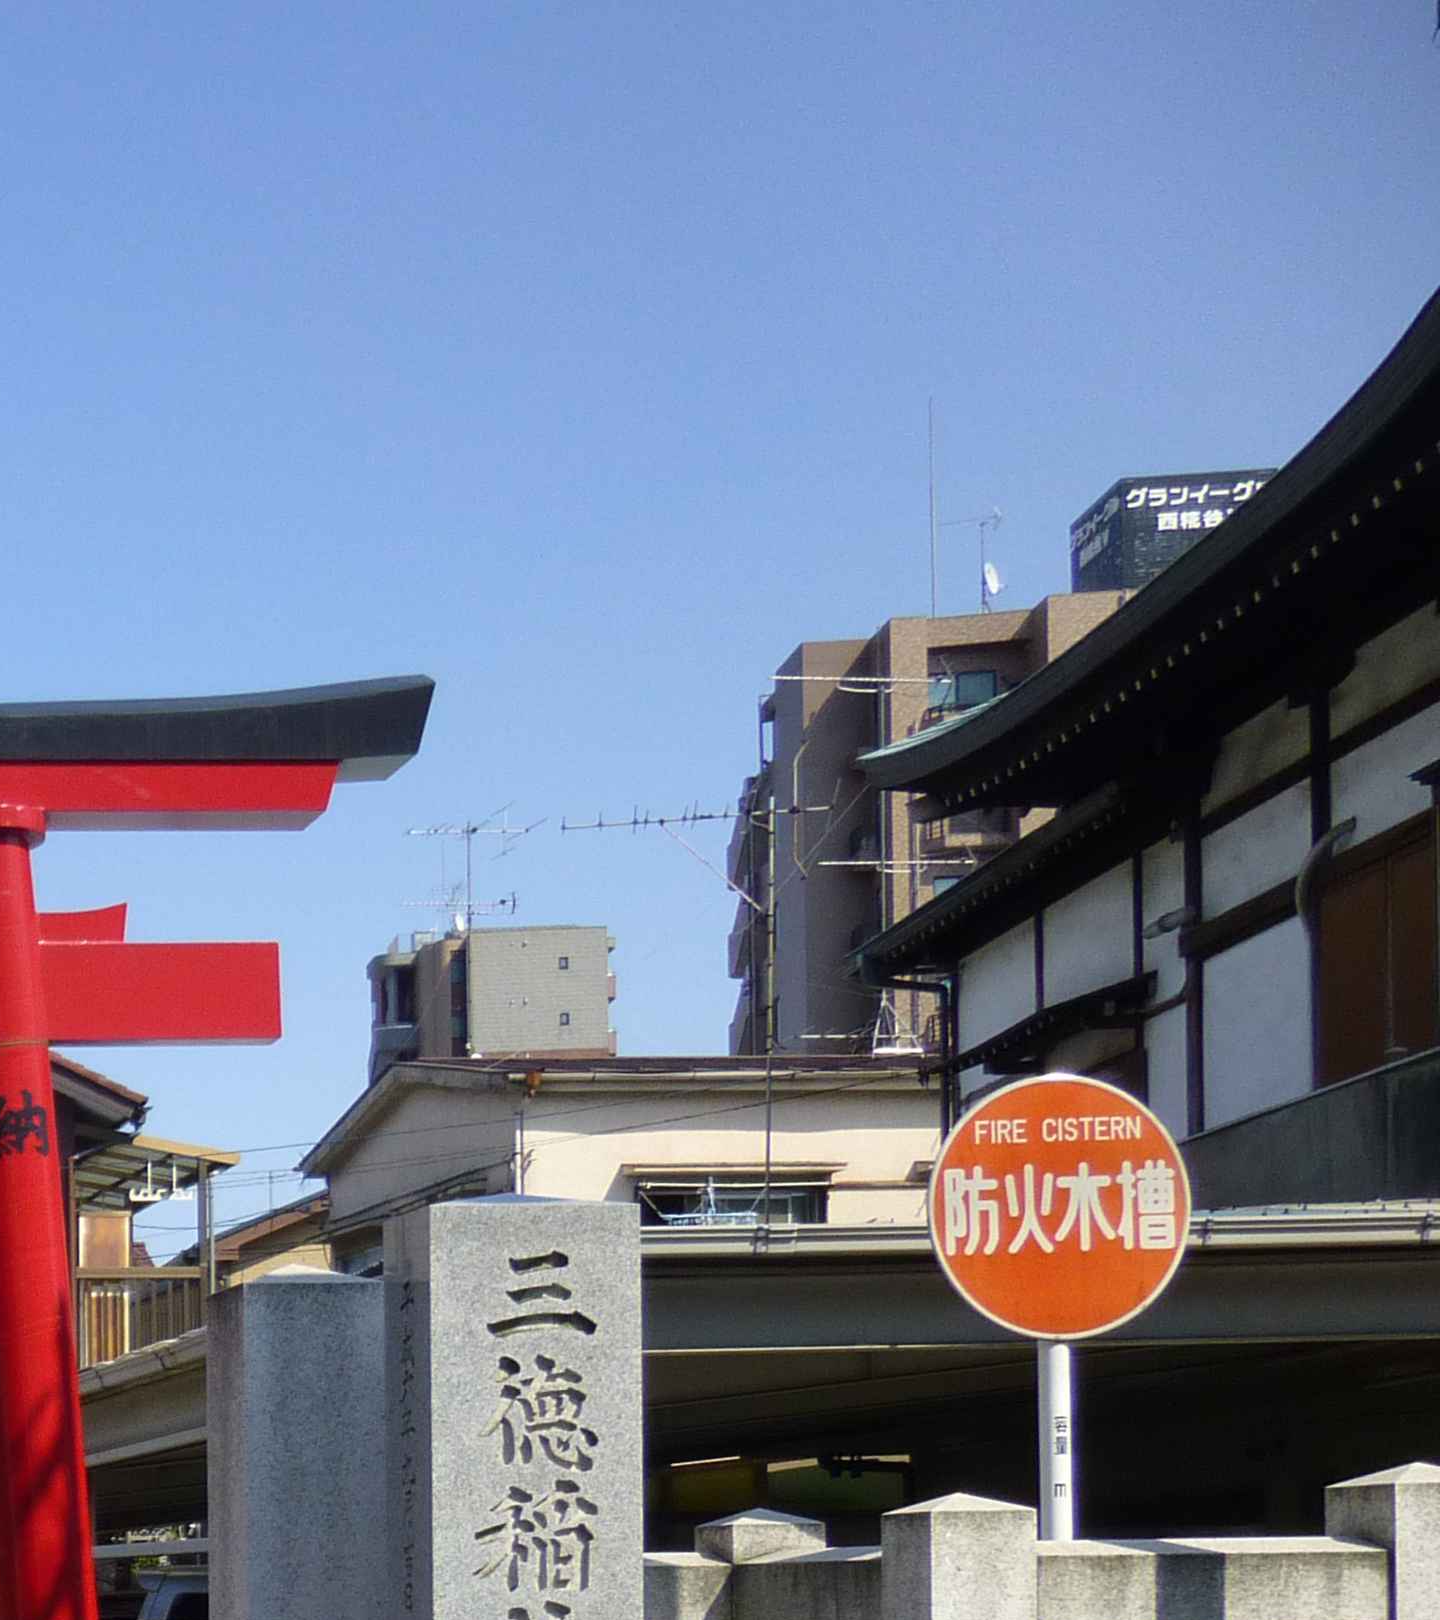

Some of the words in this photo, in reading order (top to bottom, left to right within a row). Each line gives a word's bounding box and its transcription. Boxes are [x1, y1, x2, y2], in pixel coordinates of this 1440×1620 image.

[1156, 508, 1235, 532] 西糀谷
[973, 1120, 1028, 1145] FIRE
[1041, 1115, 1143, 1143] CISTERN
